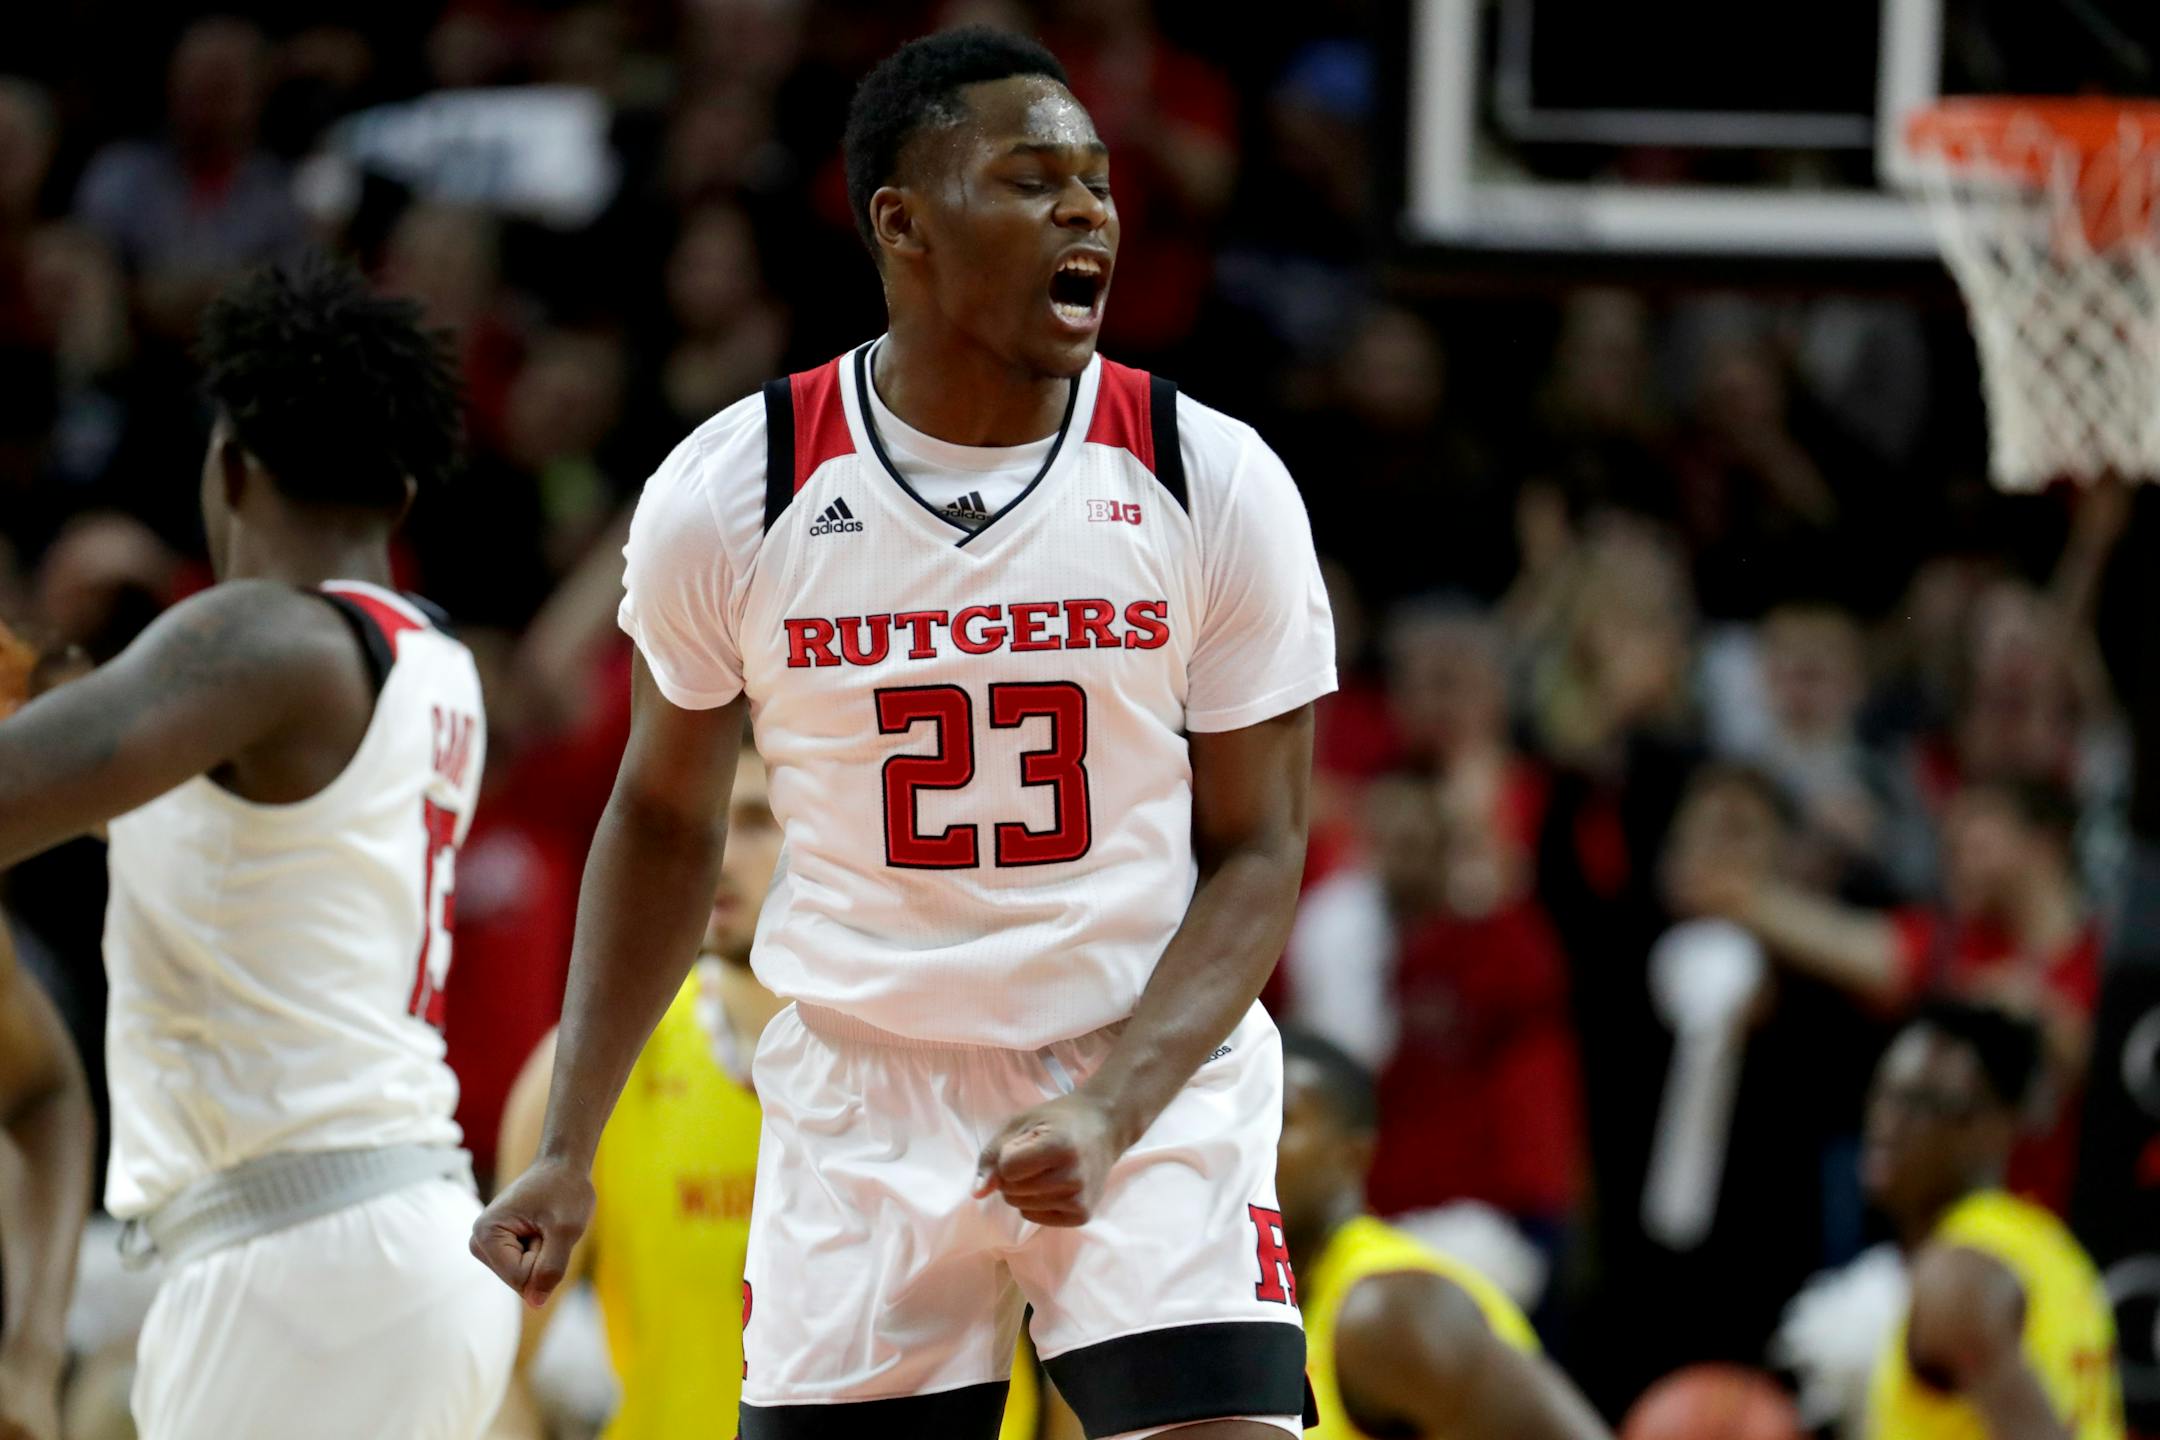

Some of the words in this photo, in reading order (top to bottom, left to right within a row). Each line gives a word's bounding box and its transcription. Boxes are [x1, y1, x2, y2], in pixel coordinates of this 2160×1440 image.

[809, 519, 864, 537] adidas
[783, 598, 1171, 669] RUTGERS
[873, 680, 1092, 870] 23
